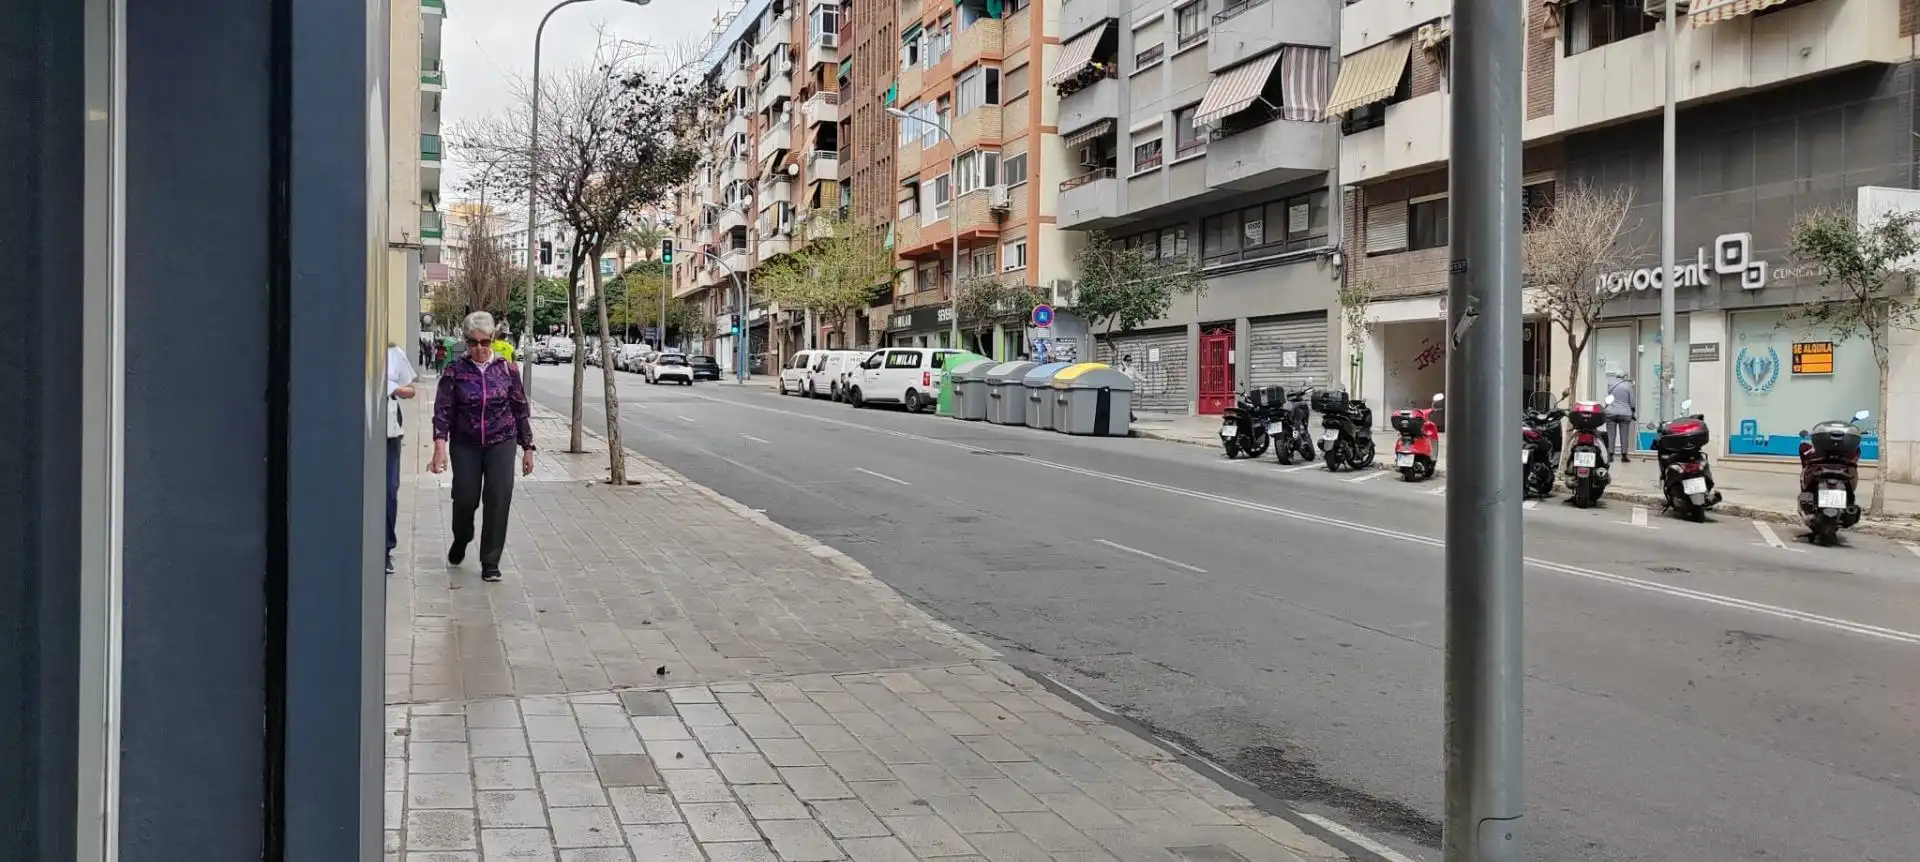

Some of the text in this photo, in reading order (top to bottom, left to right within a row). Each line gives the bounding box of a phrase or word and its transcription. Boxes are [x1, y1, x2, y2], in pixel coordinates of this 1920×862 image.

[1793, 343, 1832, 354] SE ALQUILA
[896, 354, 918, 366] MILAR
